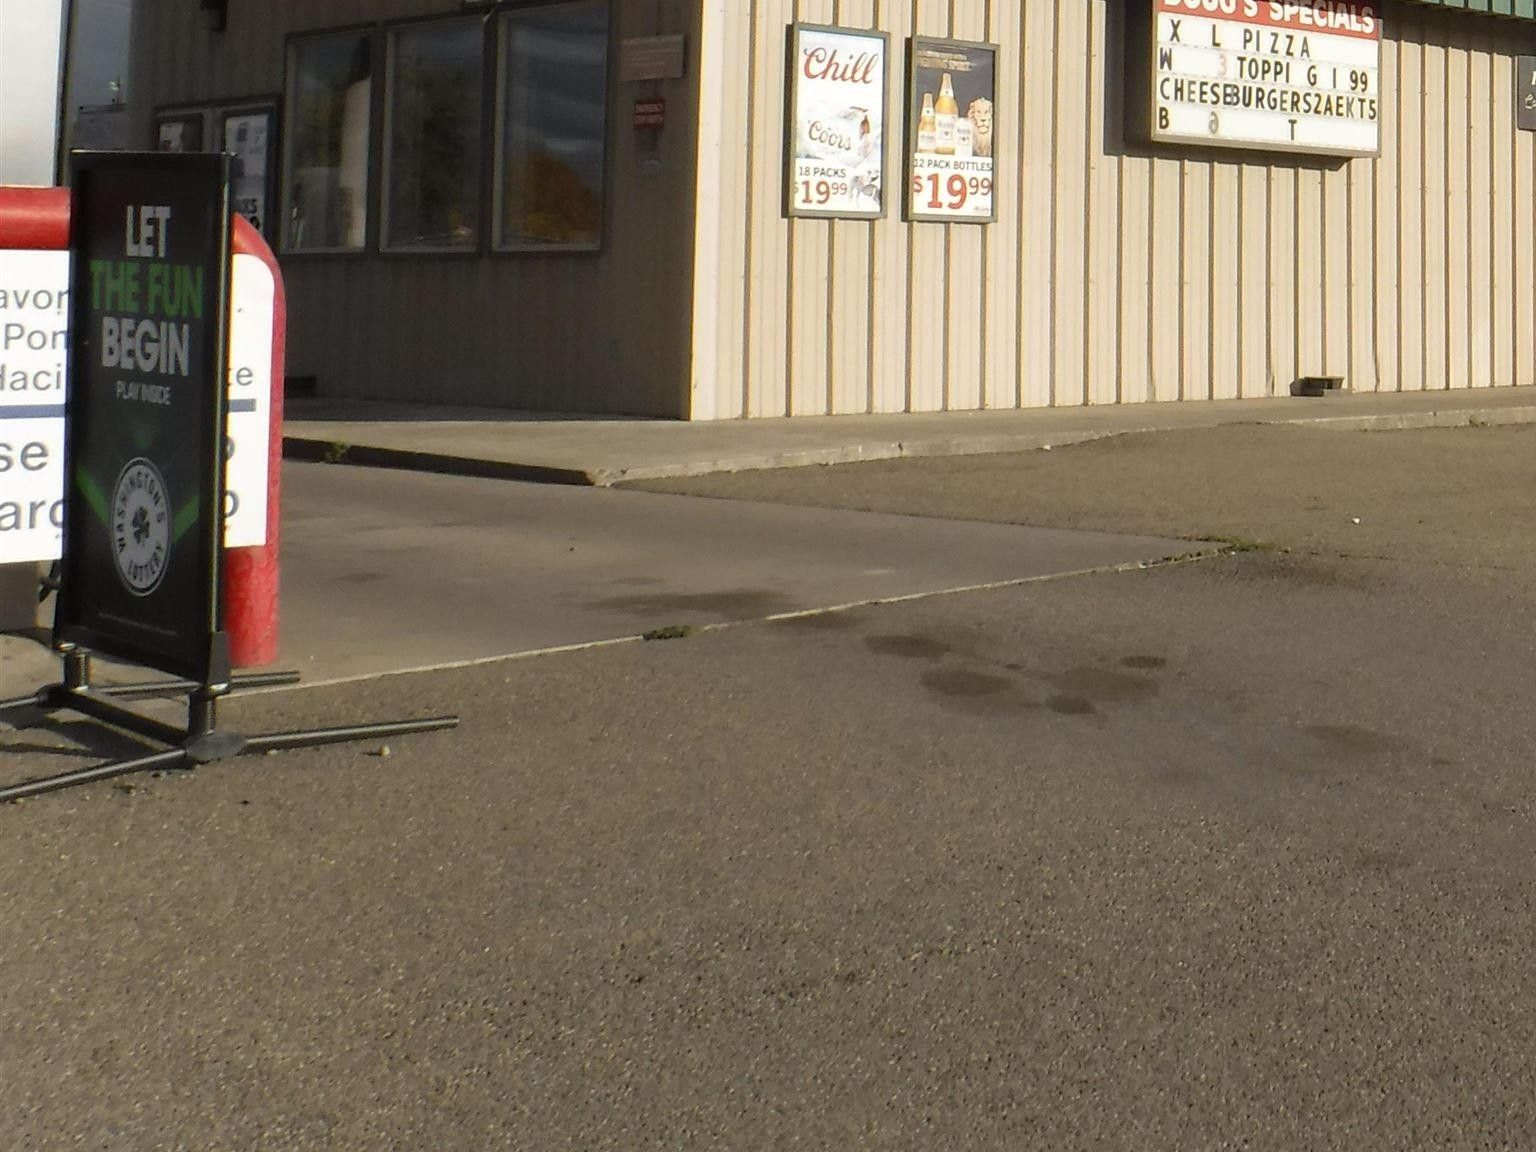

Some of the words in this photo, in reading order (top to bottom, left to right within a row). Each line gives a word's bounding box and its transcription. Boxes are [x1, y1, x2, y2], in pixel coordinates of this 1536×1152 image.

[1169, 19, 1181, 42] X
[1212, 24, 1221, 47] L
[1243, 28, 1310, 58] PIZZA
[803, 47, 879, 85] Chill
[1159, 47, 1172, 71] W
[1349, 70, 1368, 93] 99
[807, 119, 851, 152] Coors
[1159, 106, 1170, 130] B
[1288, 119, 1297, 141] T
[799, 166, 811, 177] 18
[813, 167, 847, 179] PACKS
[914, 159, 925, 169] 12
[927, 159, 951, 170] PACK
[953, 161, 993, 172] BOTTLES
[126, 205, 171, 258] LET
[89, 259, 140, 314] THE
[148, 262, 204, 320] FUN
[102, 316, 190, 377] BEGIN
